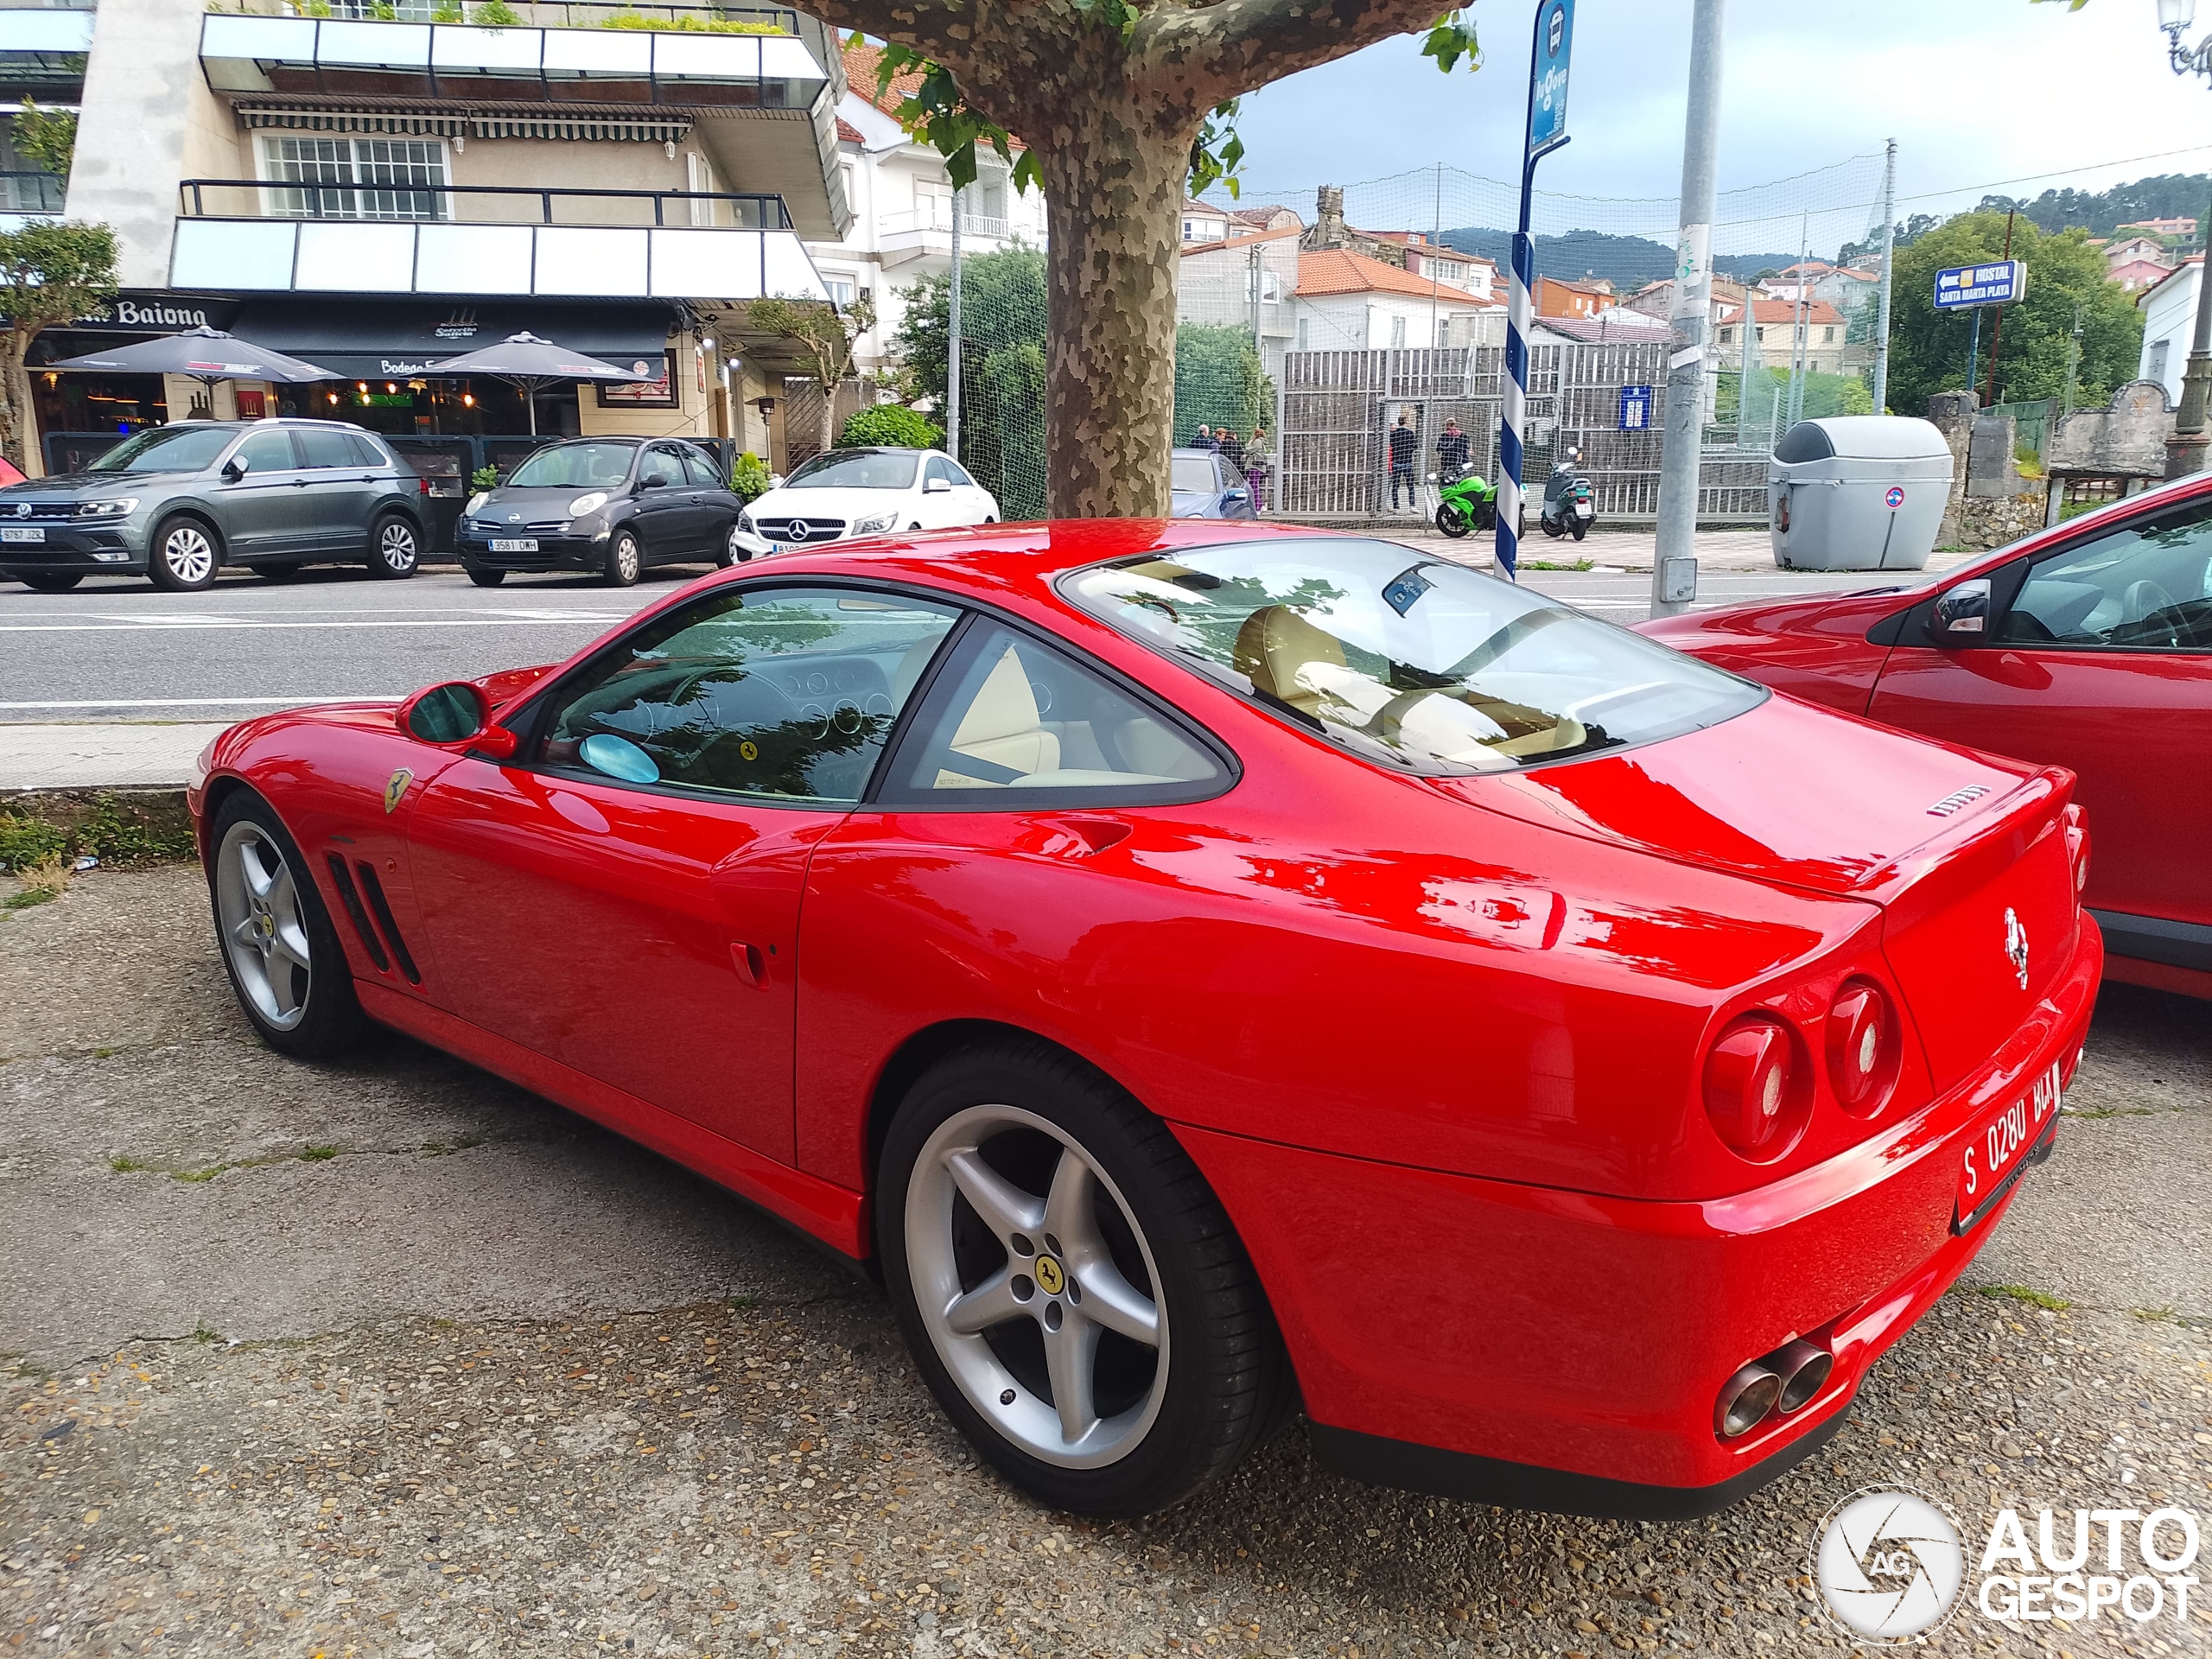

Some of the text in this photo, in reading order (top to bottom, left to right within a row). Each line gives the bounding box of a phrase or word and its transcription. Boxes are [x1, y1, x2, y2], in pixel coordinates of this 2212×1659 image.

[1975, 265, 2011, 283] HOSTAL
[1939, 284, 2010, 303] SANTA MARTA PLAYA
[116, 302, 207, 326] Baiona
[494, 541, 515, 550] 3581
[1964, 1146, 1977, 1195] S
[1987, 1098, 2026, 1172] 0280
